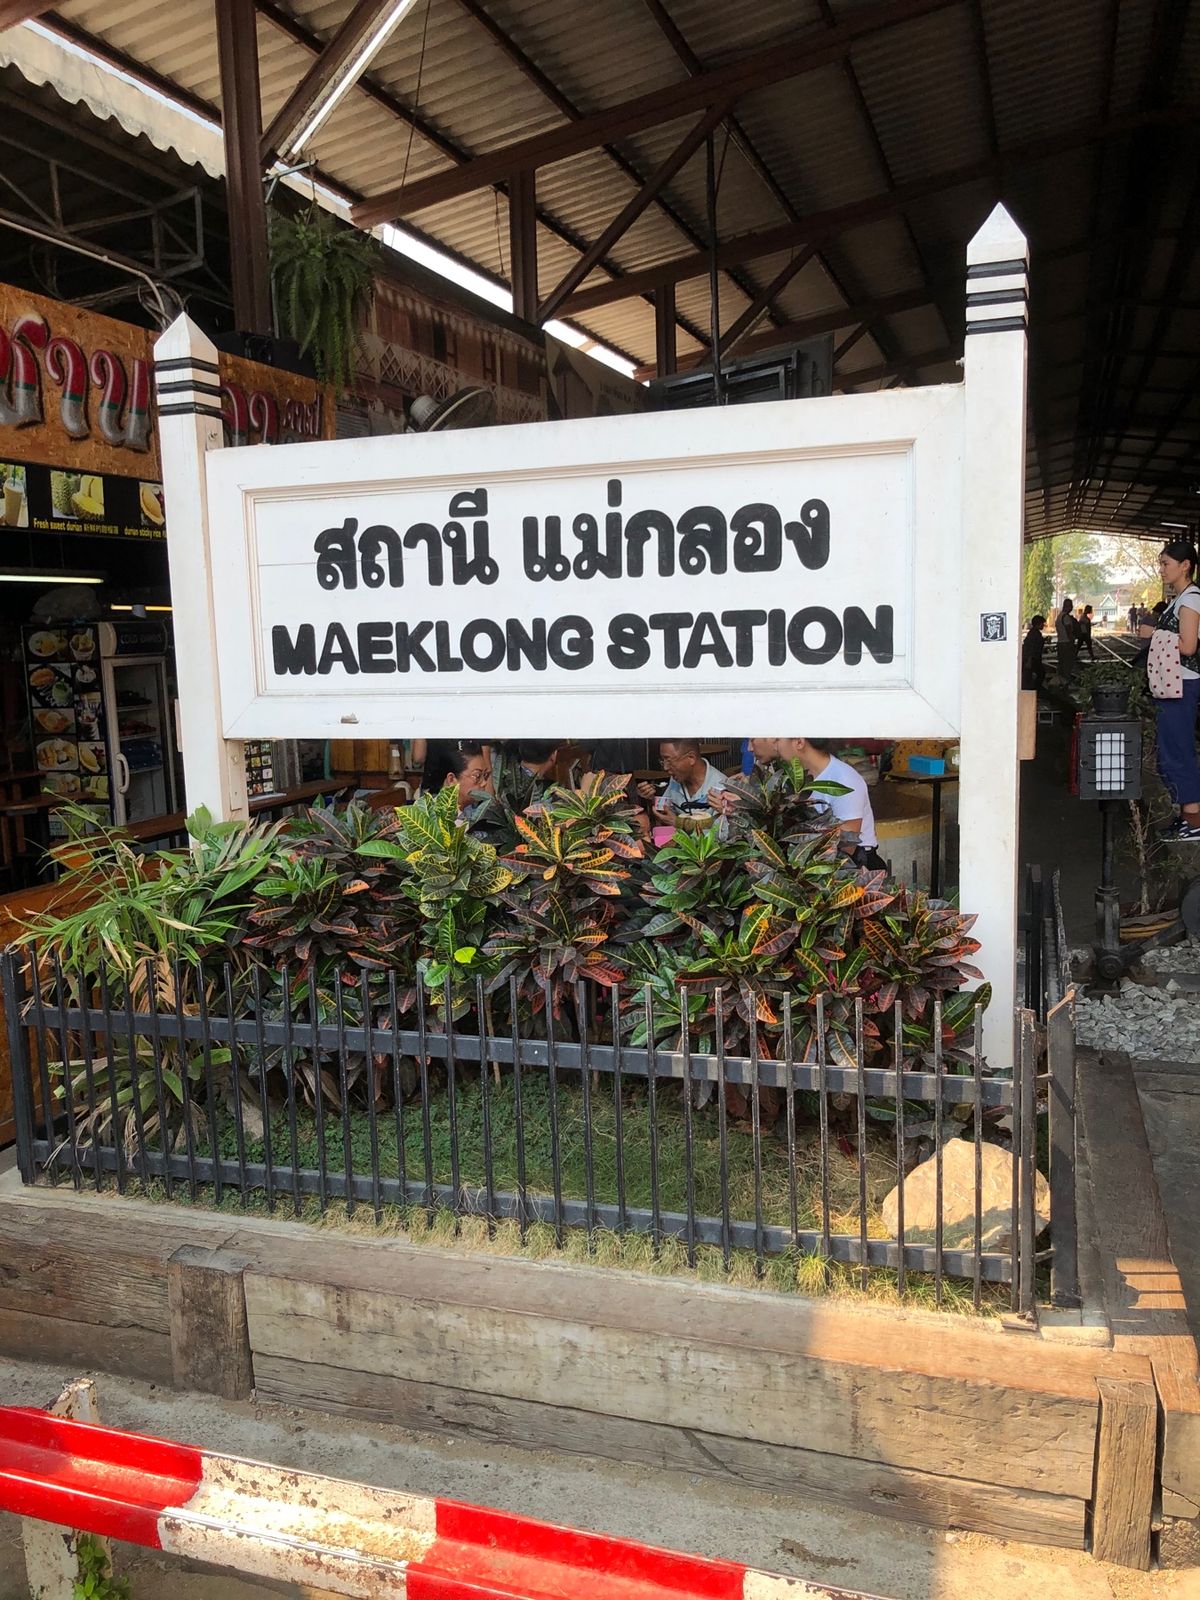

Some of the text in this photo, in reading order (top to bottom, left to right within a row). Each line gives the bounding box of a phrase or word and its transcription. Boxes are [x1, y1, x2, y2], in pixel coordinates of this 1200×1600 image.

[33, 517, 49, 529] Fresh
[50, 521, 65, 531] sweet
[314, 479, 829, 590] สถานี แม่กลอง
[272, 605, 893, 675] MAEKLONG STATION
